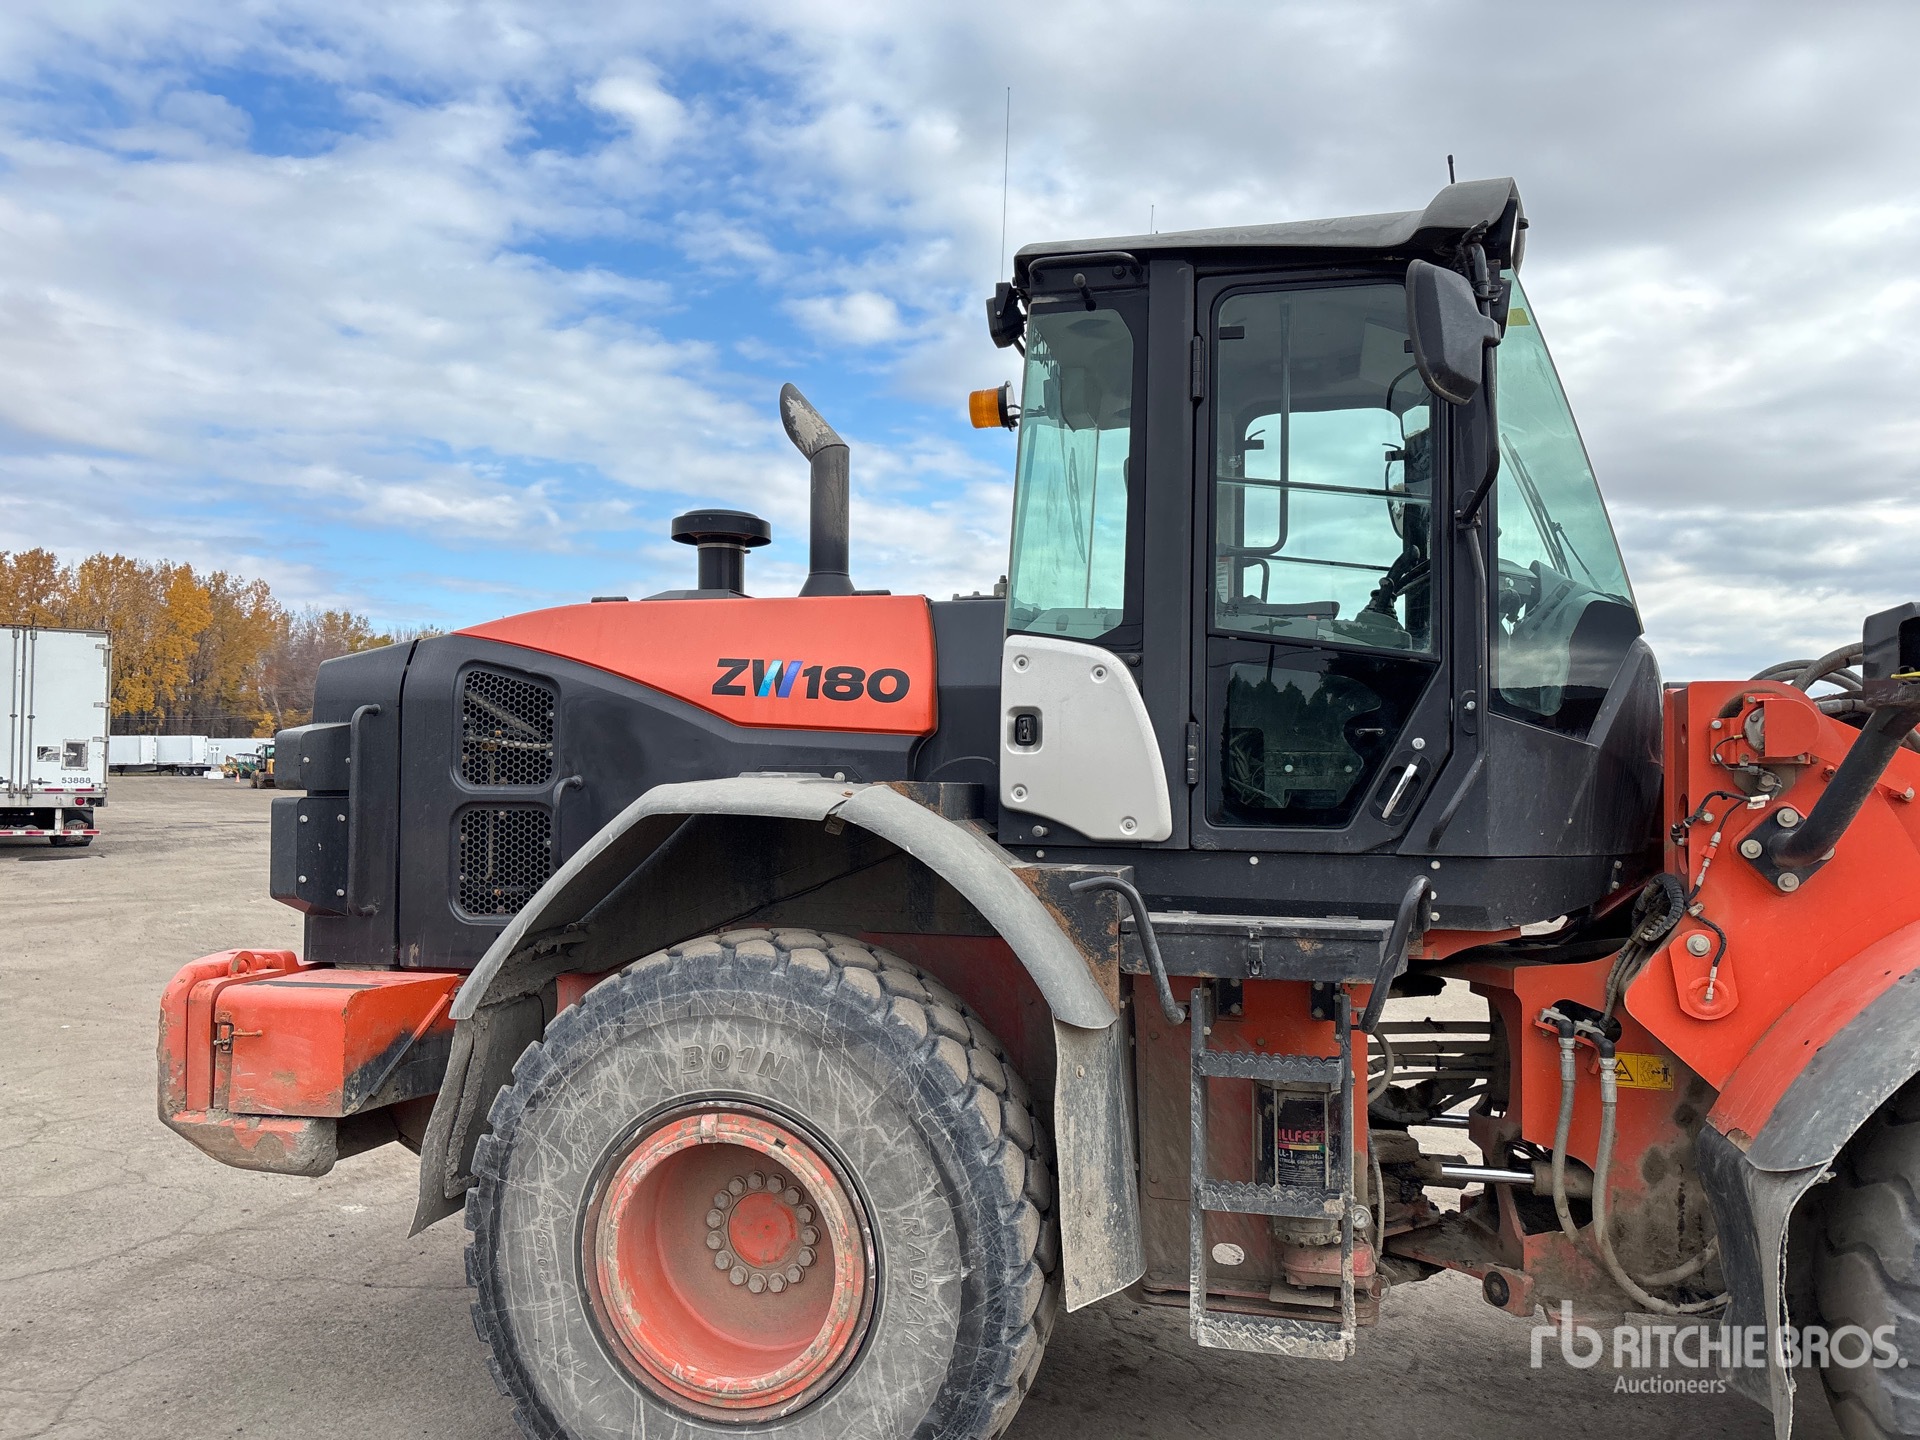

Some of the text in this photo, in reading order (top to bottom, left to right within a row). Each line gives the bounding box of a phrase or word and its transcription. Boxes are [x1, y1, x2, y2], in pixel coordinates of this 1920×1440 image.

[712, 658, 910, 703] ZW180
[681, 1043, 791, 1081] B01N
[901, 1217, 928, 1346] RADIAL
